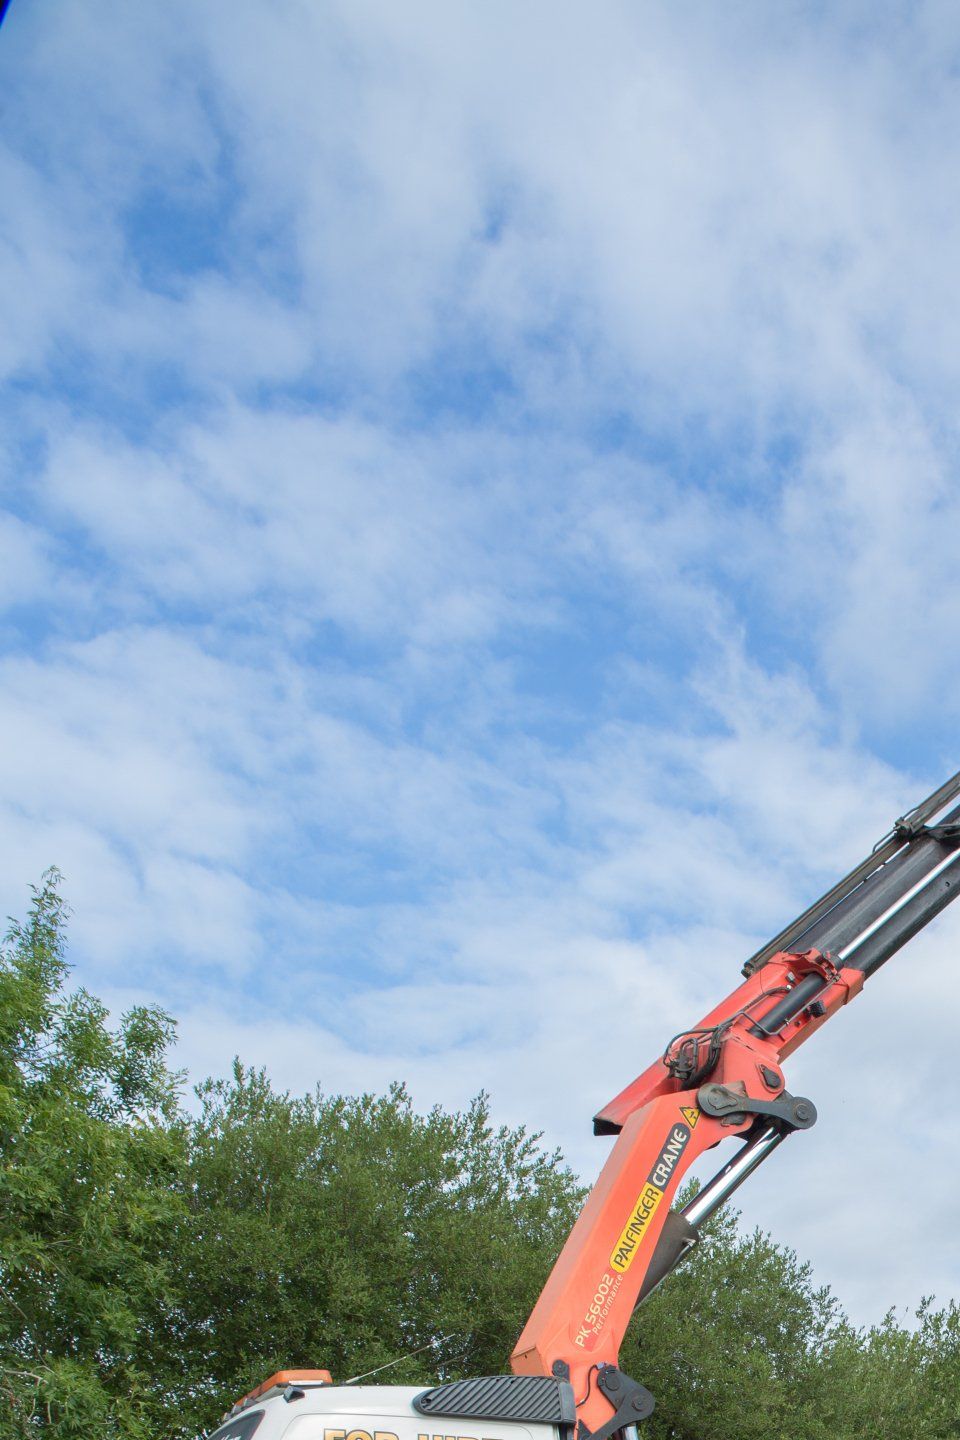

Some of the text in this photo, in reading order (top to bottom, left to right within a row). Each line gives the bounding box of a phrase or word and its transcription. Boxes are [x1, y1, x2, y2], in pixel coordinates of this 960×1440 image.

[613, 1128, 688, 1268] PALFINGER CRANE
[575, 1273, 615, 1348] PK 56002
[592, 1274, 624, 1336] Performance
